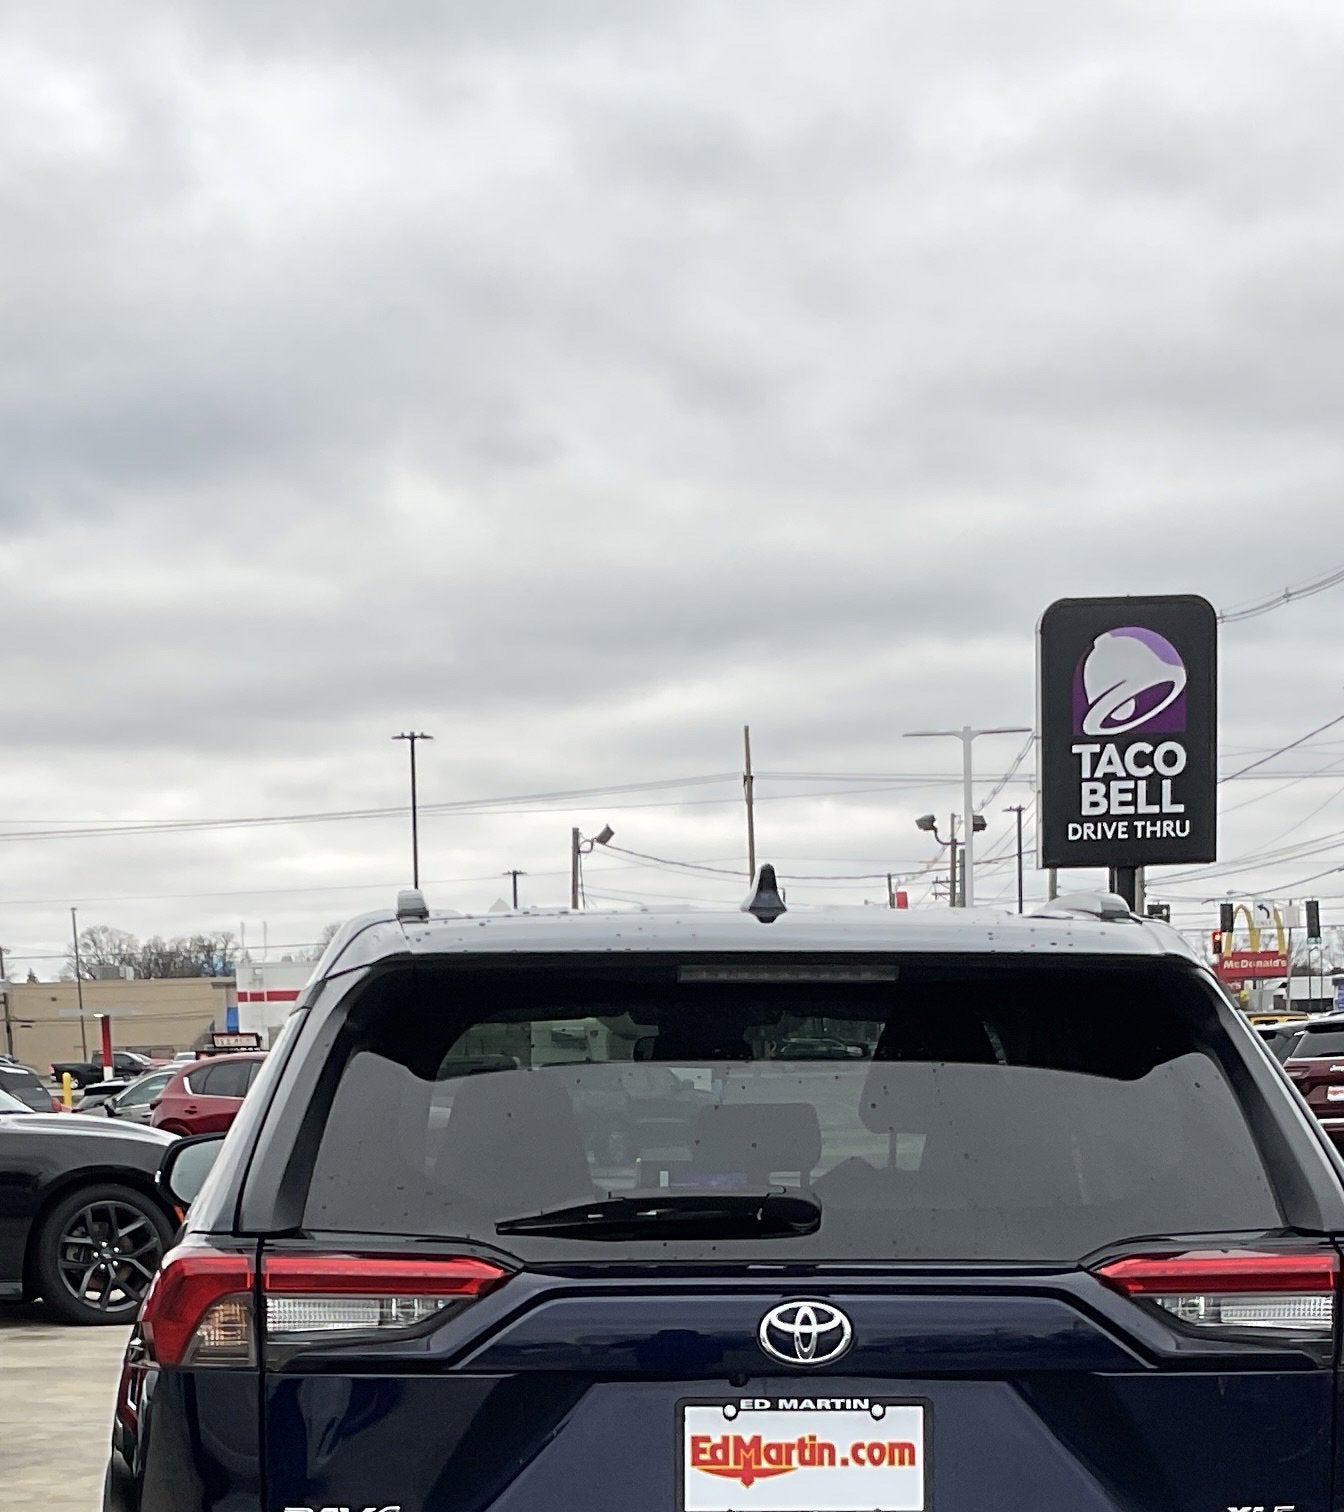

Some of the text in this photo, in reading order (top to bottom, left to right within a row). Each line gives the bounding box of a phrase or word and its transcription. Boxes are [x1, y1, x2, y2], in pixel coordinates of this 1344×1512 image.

[1071, 741, 1188, 779] TACO
[1080, 779, 1185, 816] BELL
[1067, 819, 1191, 841] DRIVE THRU
[1223, 957, 1288, 970] McDonald's
[739, 1398, 871, 1410] ED MARTIN
[690, 1434, 917, 1473] EdMartin.com
